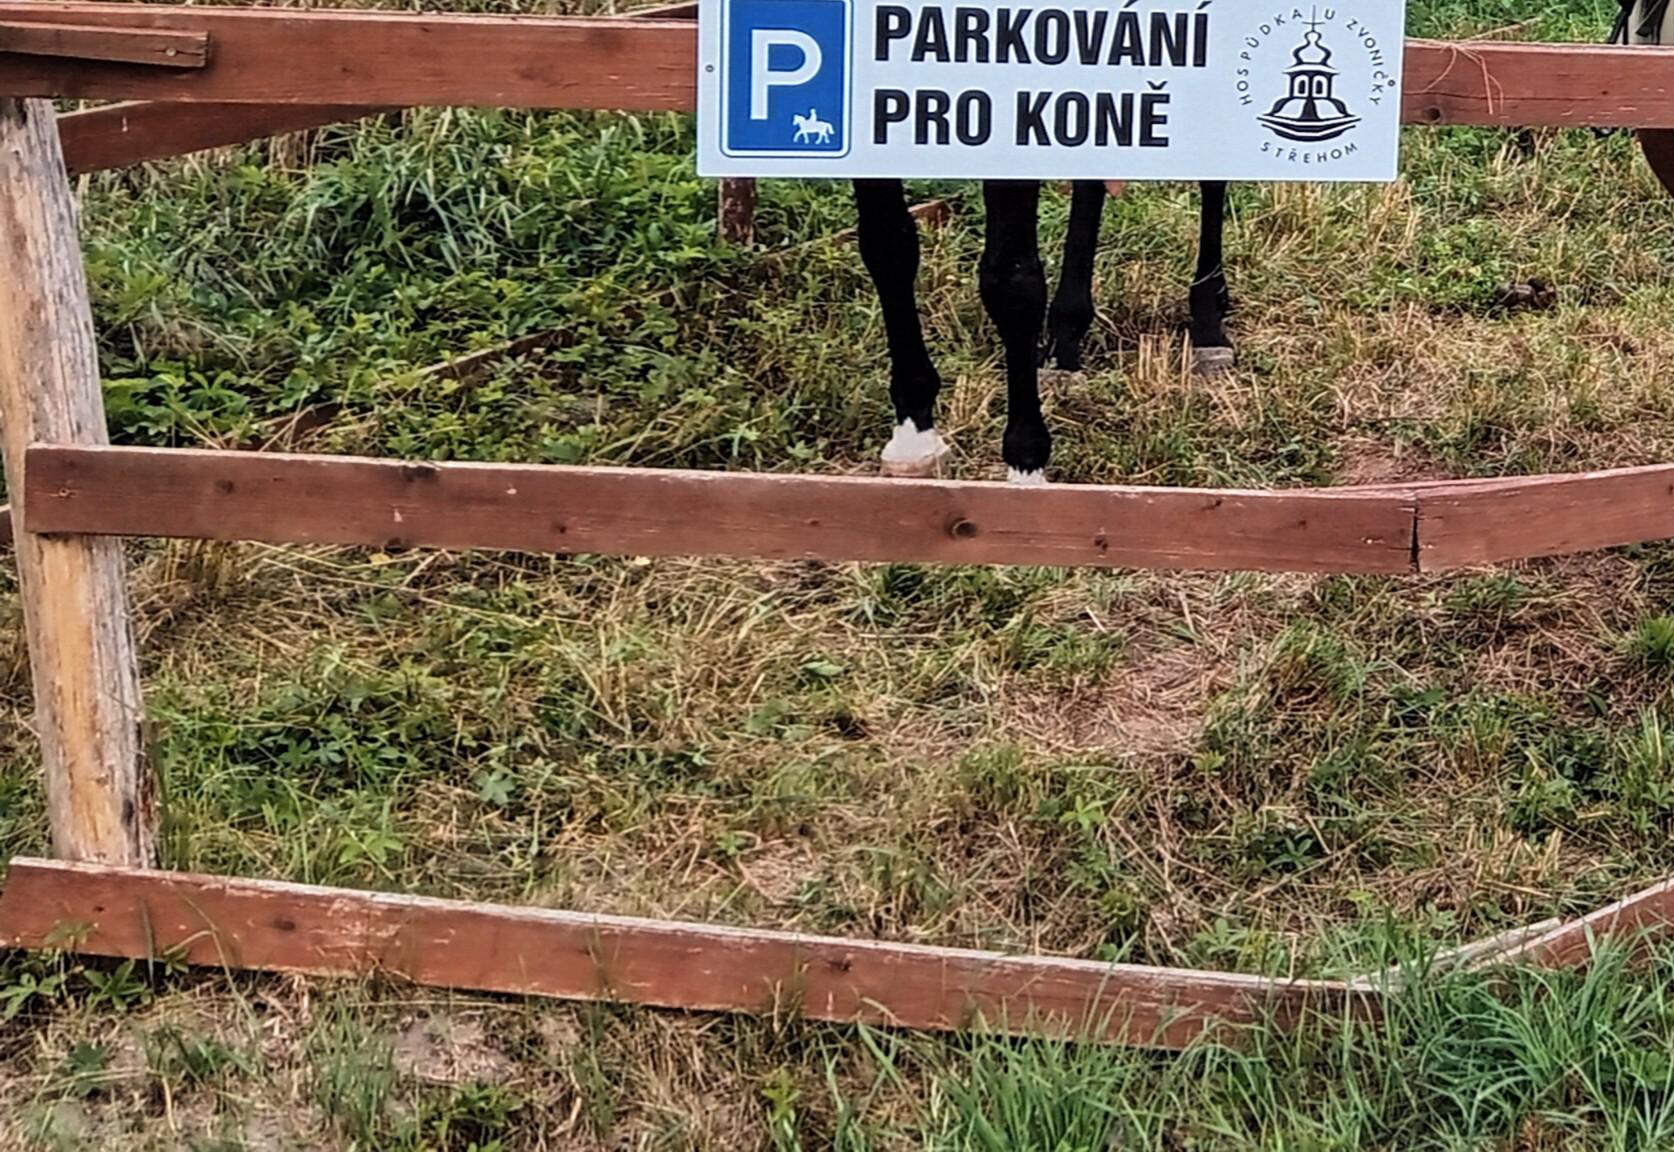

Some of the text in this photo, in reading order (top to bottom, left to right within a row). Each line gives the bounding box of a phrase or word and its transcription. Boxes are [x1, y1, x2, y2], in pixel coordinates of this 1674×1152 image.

[749, 29, 823, 121] P
[1324, 9, 1336, 20] U
[1346, 19, 1389, 106] ZVONIČKY
[873, 81, 1171, 148] PRO KONĚ
[1260, 141, 1358, 164] STŘEHOM
